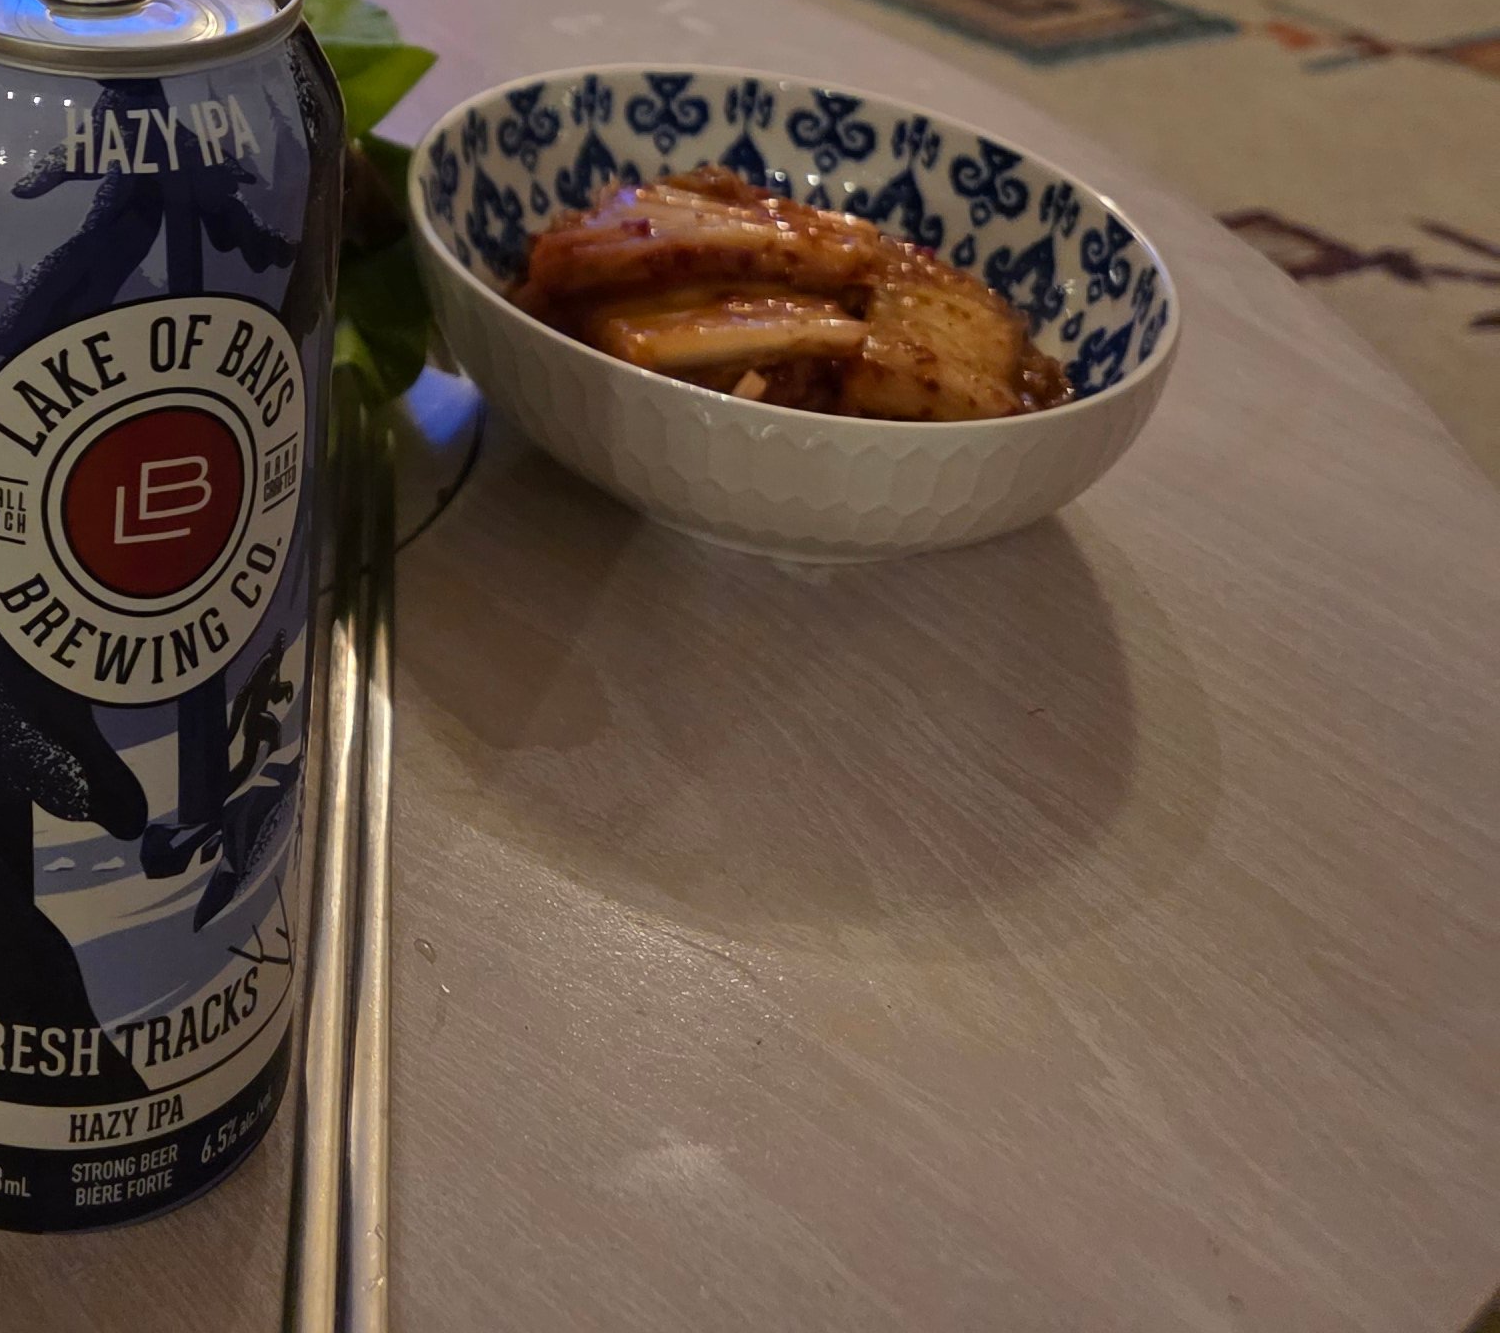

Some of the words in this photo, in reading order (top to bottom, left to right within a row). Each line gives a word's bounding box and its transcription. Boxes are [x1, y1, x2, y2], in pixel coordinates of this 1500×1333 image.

[65, 105, 180, 175] HAZY
[191, 94, 261, 168] IPA
[149, 314, 212, 374] OF
[215, 319, 296, 429] BAYS
[230, 535, 283, 609] CO.
[111, 966, 260, 1068] TRACKS
[67, 1105, 137, 1145] HAZY
[146, 1094, 186, 1133] IPA
[200, 1115, 239, 1165] 6.5%
[70, 1157, 137, 1184] STRONG
[140, 1143, 180, 1174] BEER
[74, 1179, 123, 1208] BIÈRE
[127, 1169, 174, 1199] FORTE
